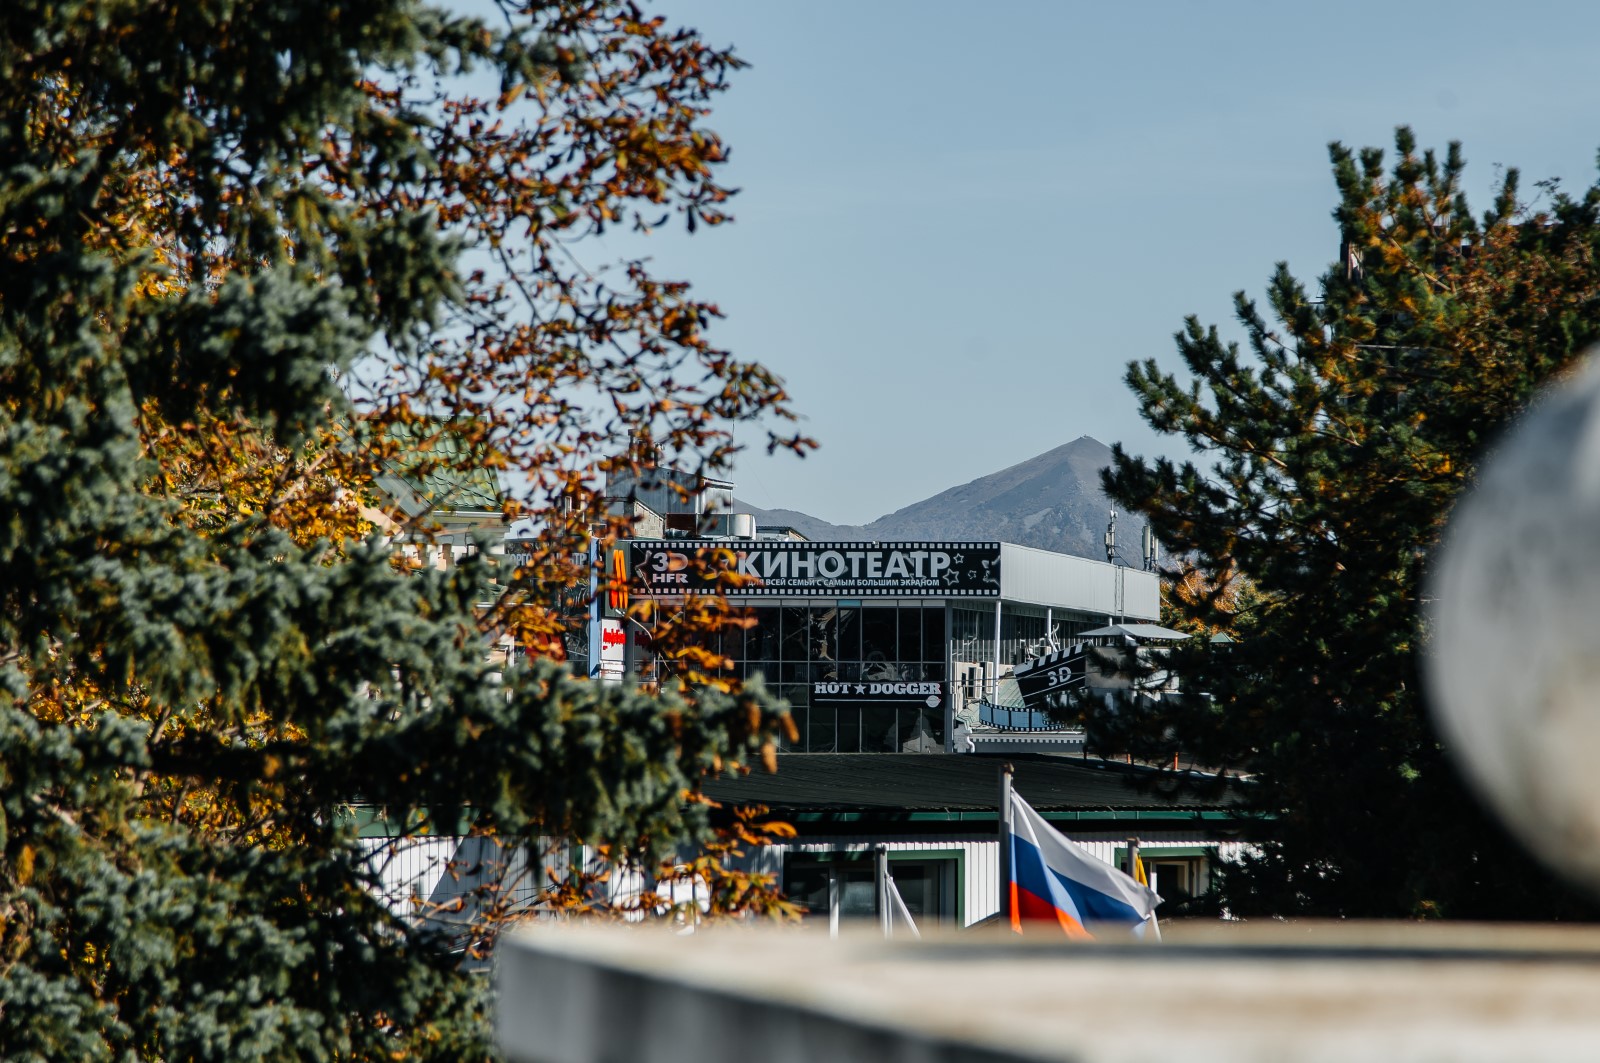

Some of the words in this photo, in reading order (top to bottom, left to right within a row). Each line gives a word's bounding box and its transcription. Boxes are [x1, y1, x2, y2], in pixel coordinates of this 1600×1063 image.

[652, 552, 689, 572] 3D
[738, 550, 951, 578] КИНОТЕАТР
[652, 573, 689, 584] HFR
[765, 577, 786, 586] ВСЕЙ
[816, 579, 822, 587] С
[823, 579, 856, 587] САМЫМ
[857, 579, 899, 587] БОЛЬШИМ
[900, 579, 940, 587] ЭКРАНОМ
[1048, 666, 1072, 687] 3D
[814, 681, 852, 695] HOT
[869, 682, 942, 695] DOGGER
